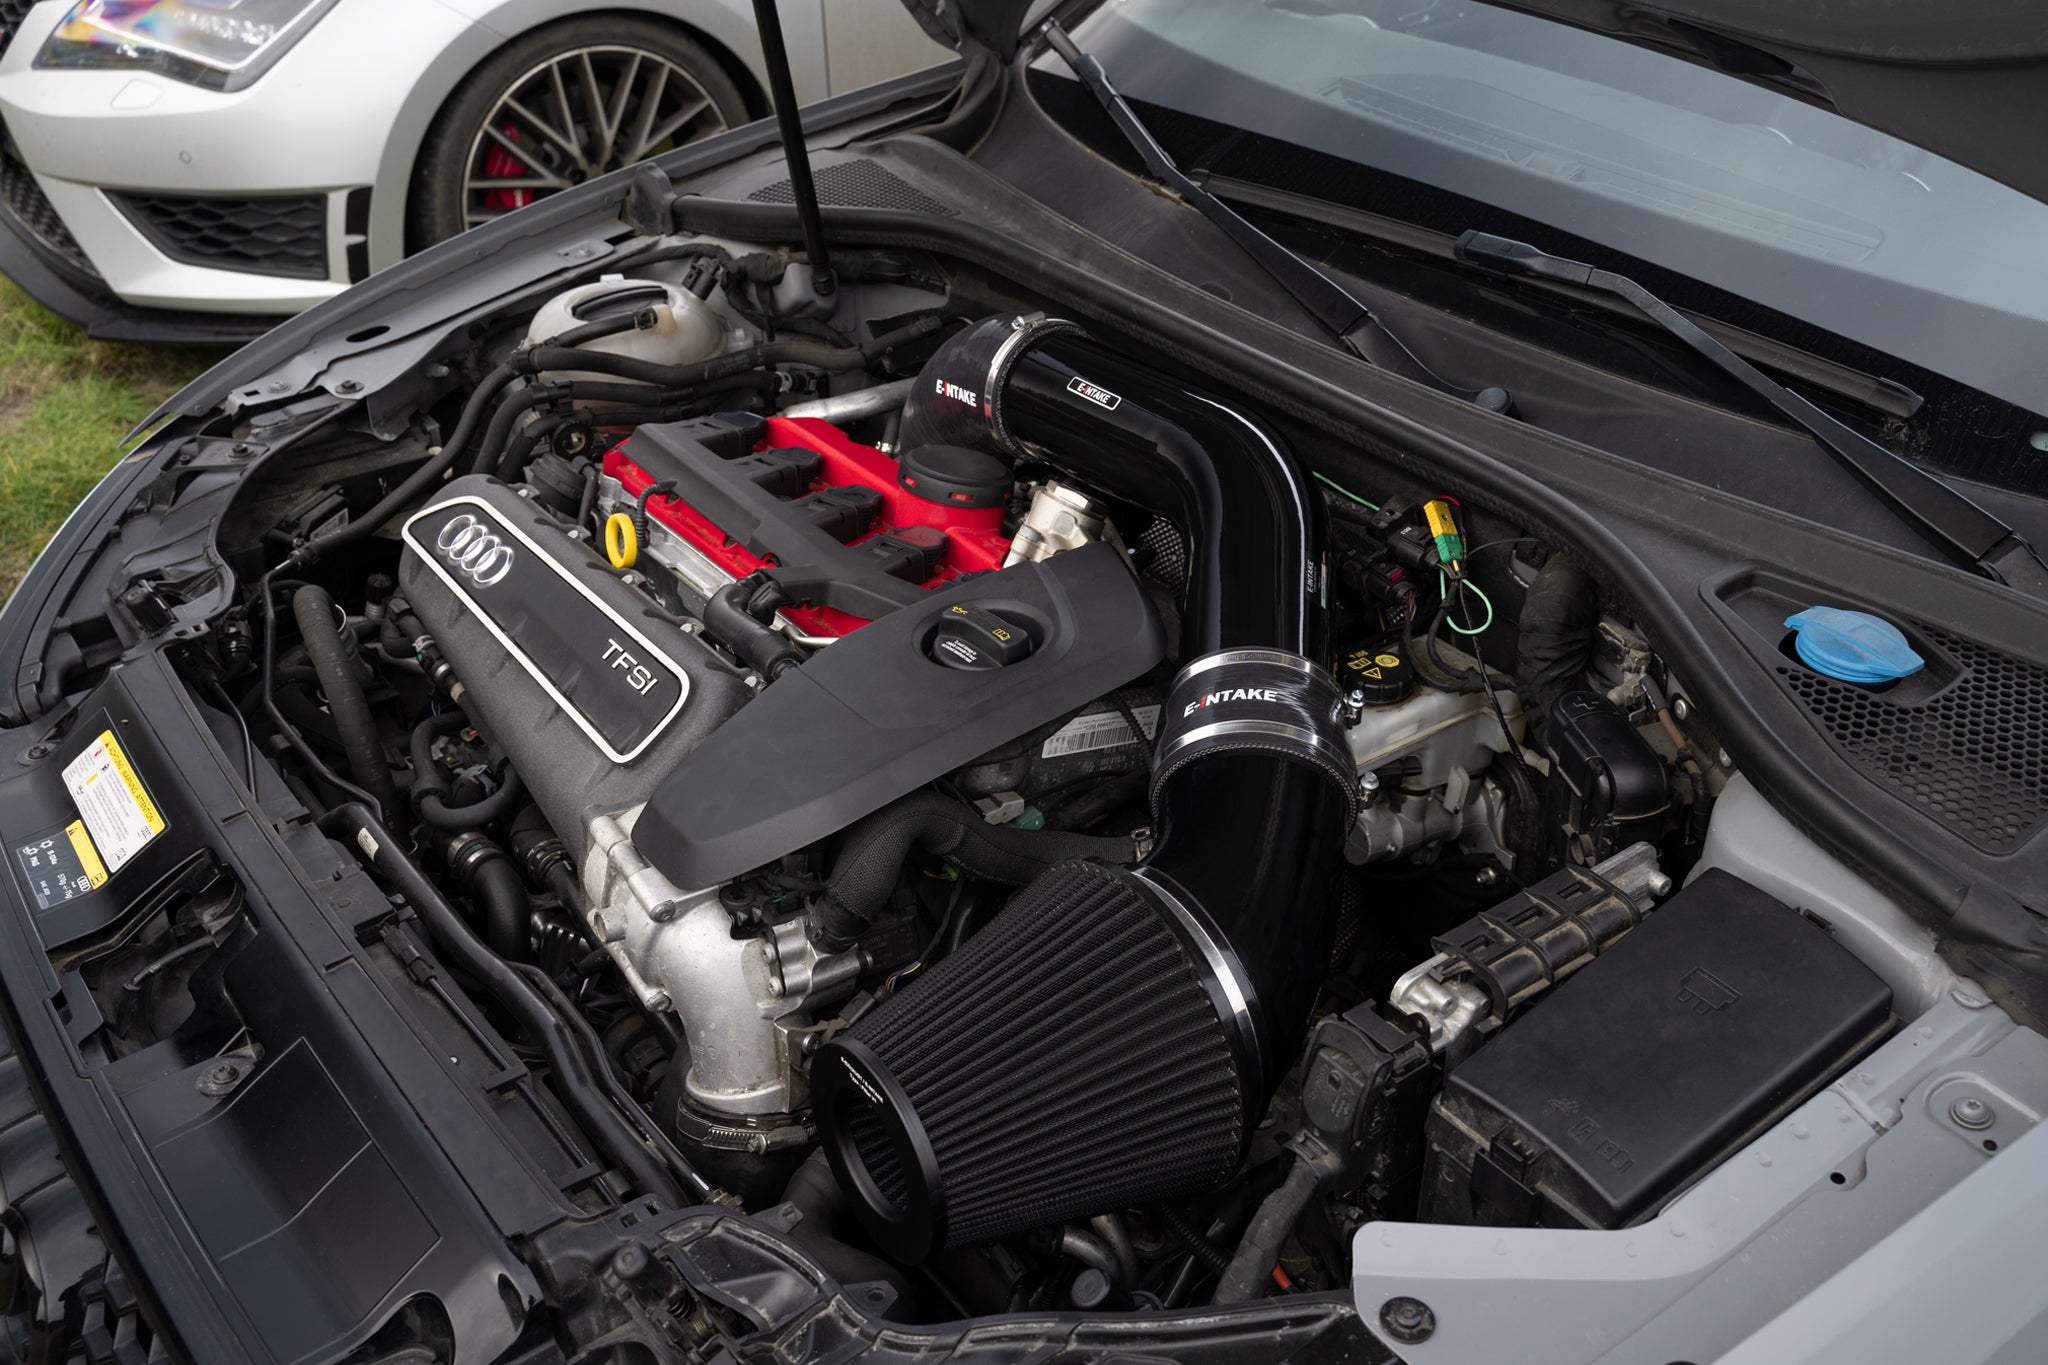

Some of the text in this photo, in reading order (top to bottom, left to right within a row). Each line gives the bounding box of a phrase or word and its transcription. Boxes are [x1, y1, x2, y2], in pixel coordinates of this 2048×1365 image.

[936, 379, 977, 407] E-INTAKE
[1077, 383, 1111, 404] E-INTAKE
[602, 638, 658, 695] TFSI
[1183, 688, 1278, 718] E-INTAKE
[108, 747, 154, 822] ACHTUNG WARNING ATTENTION
